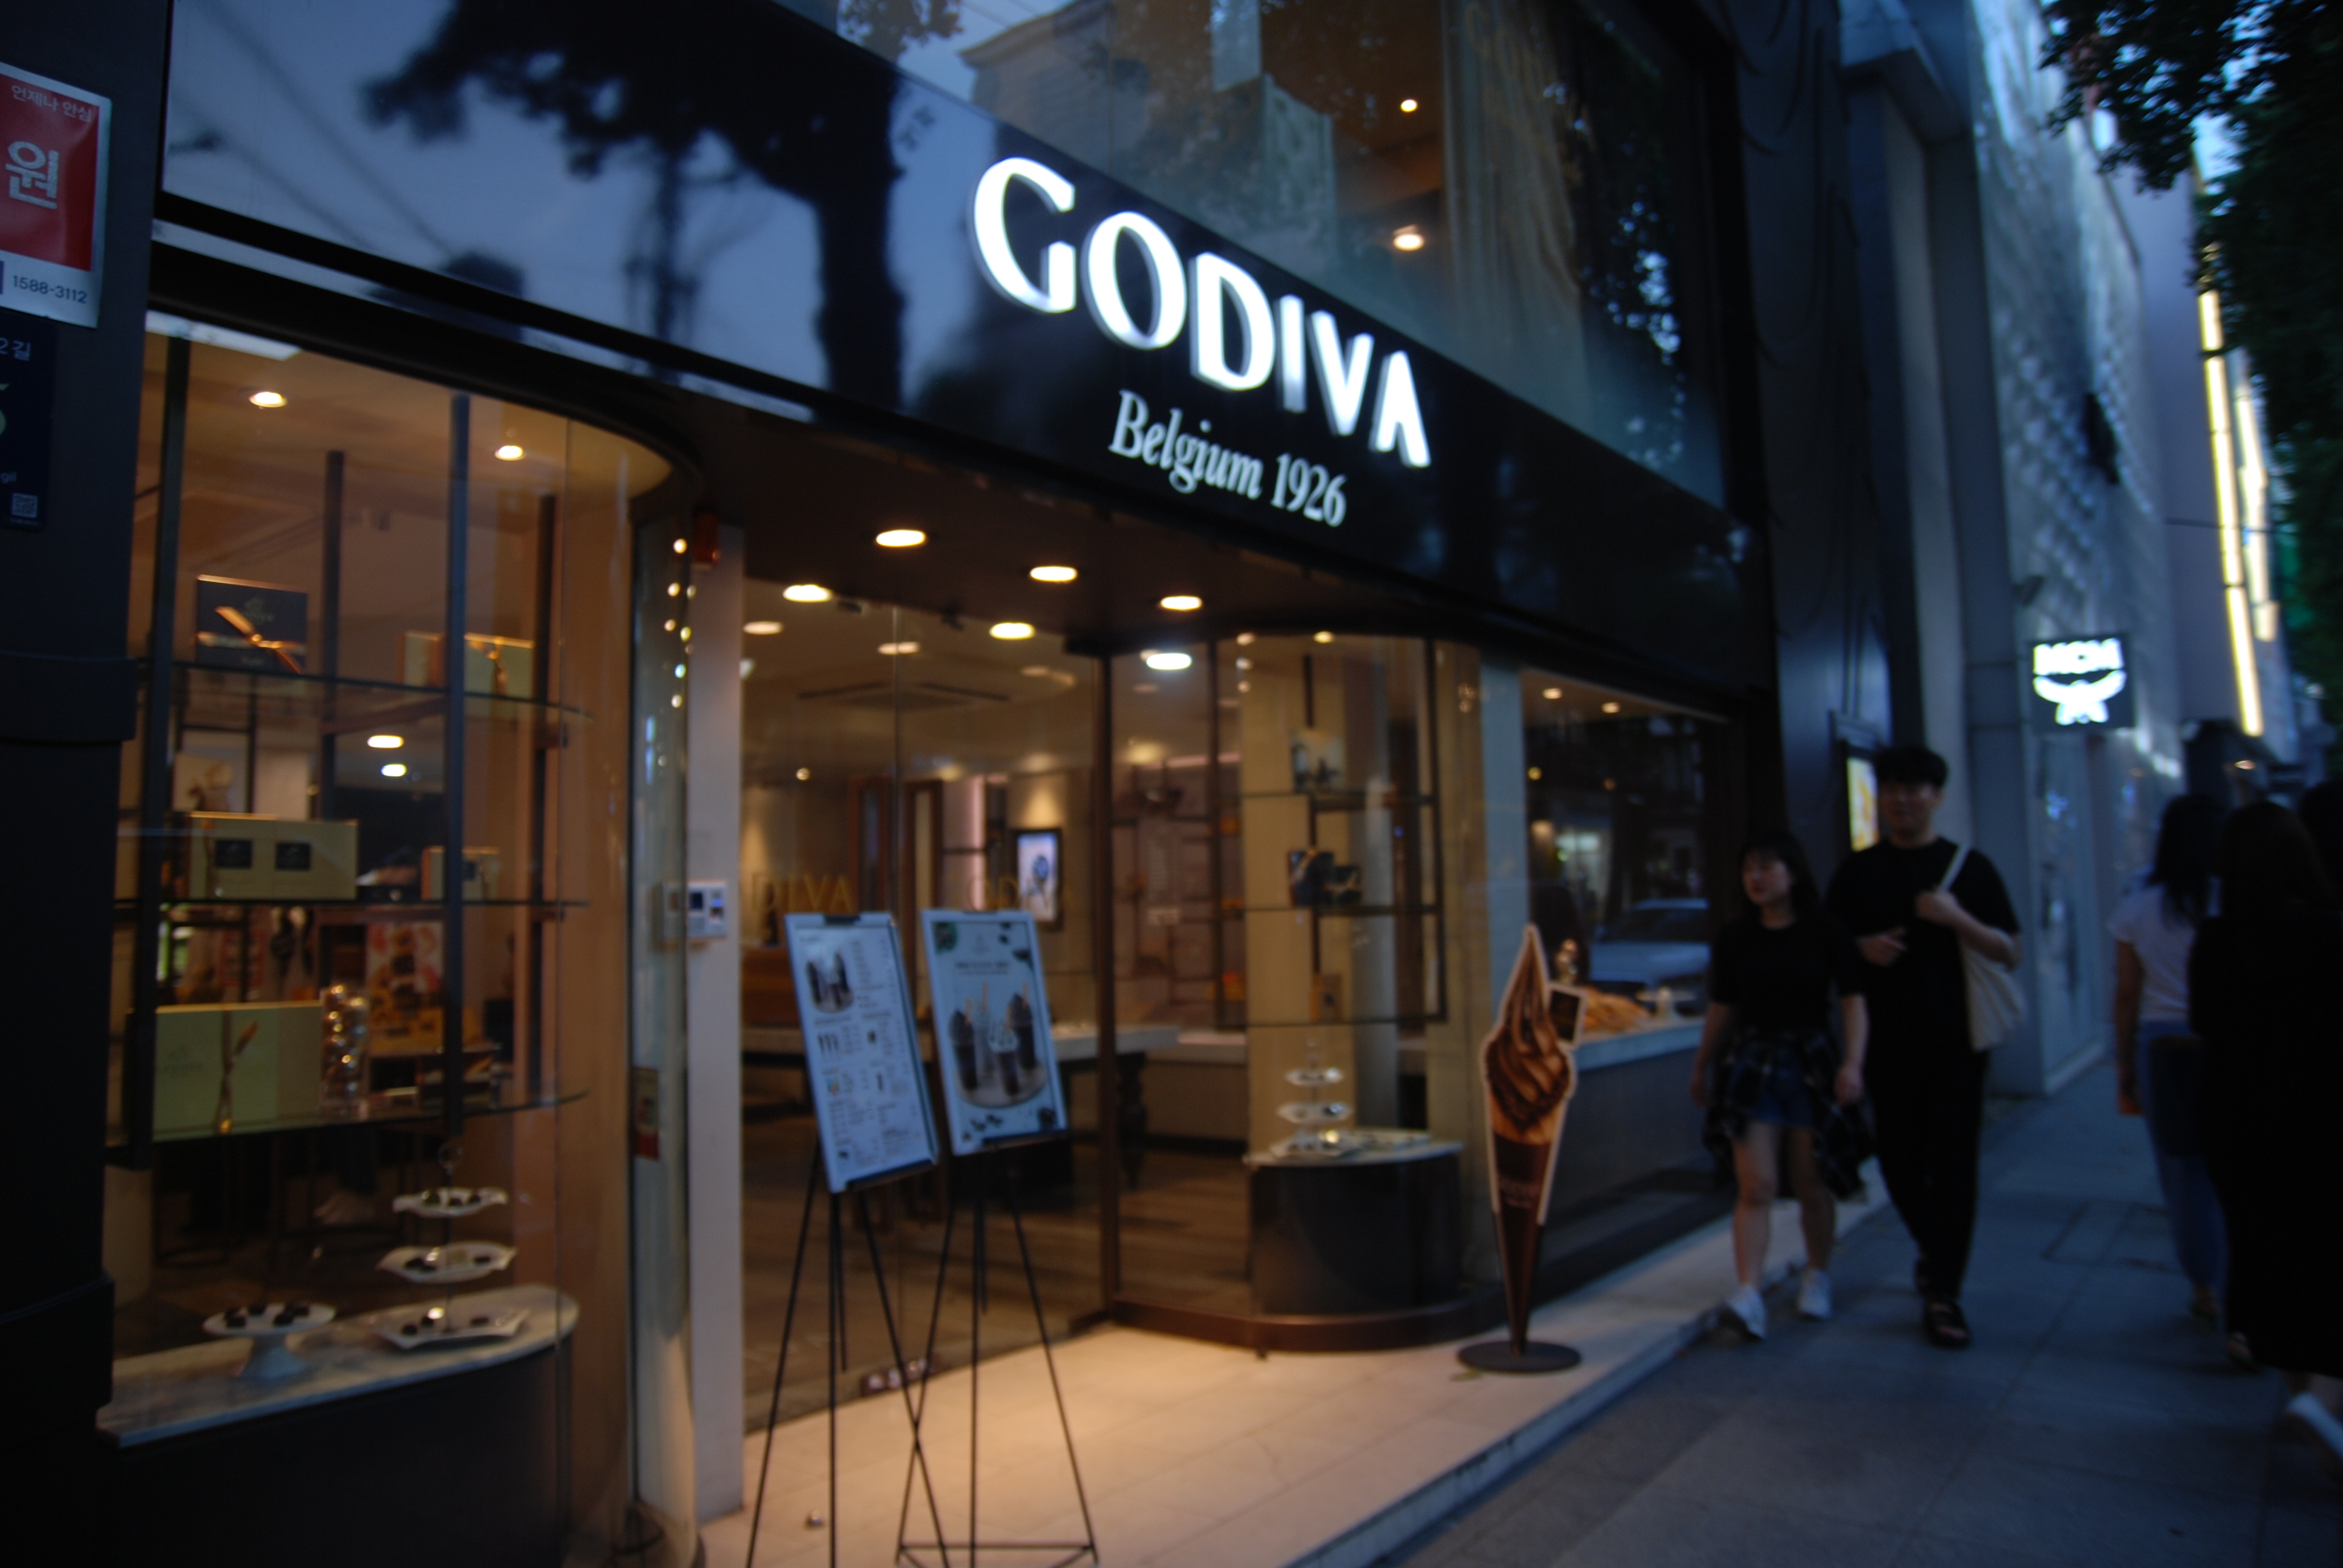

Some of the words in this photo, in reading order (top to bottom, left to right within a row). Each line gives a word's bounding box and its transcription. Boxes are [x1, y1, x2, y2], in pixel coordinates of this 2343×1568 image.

[11, 85, 59, 113] 언제나
[62, 101, 93, 123] 안심
[5, 140, 59, 209] 원
[13, 275, 88, 304] 1588-3112
[971, 157, 1431, 468] GODIVA
[1109, 388, 1263, 495] Belgium
[1270, 452, 1349, 528] 1926
